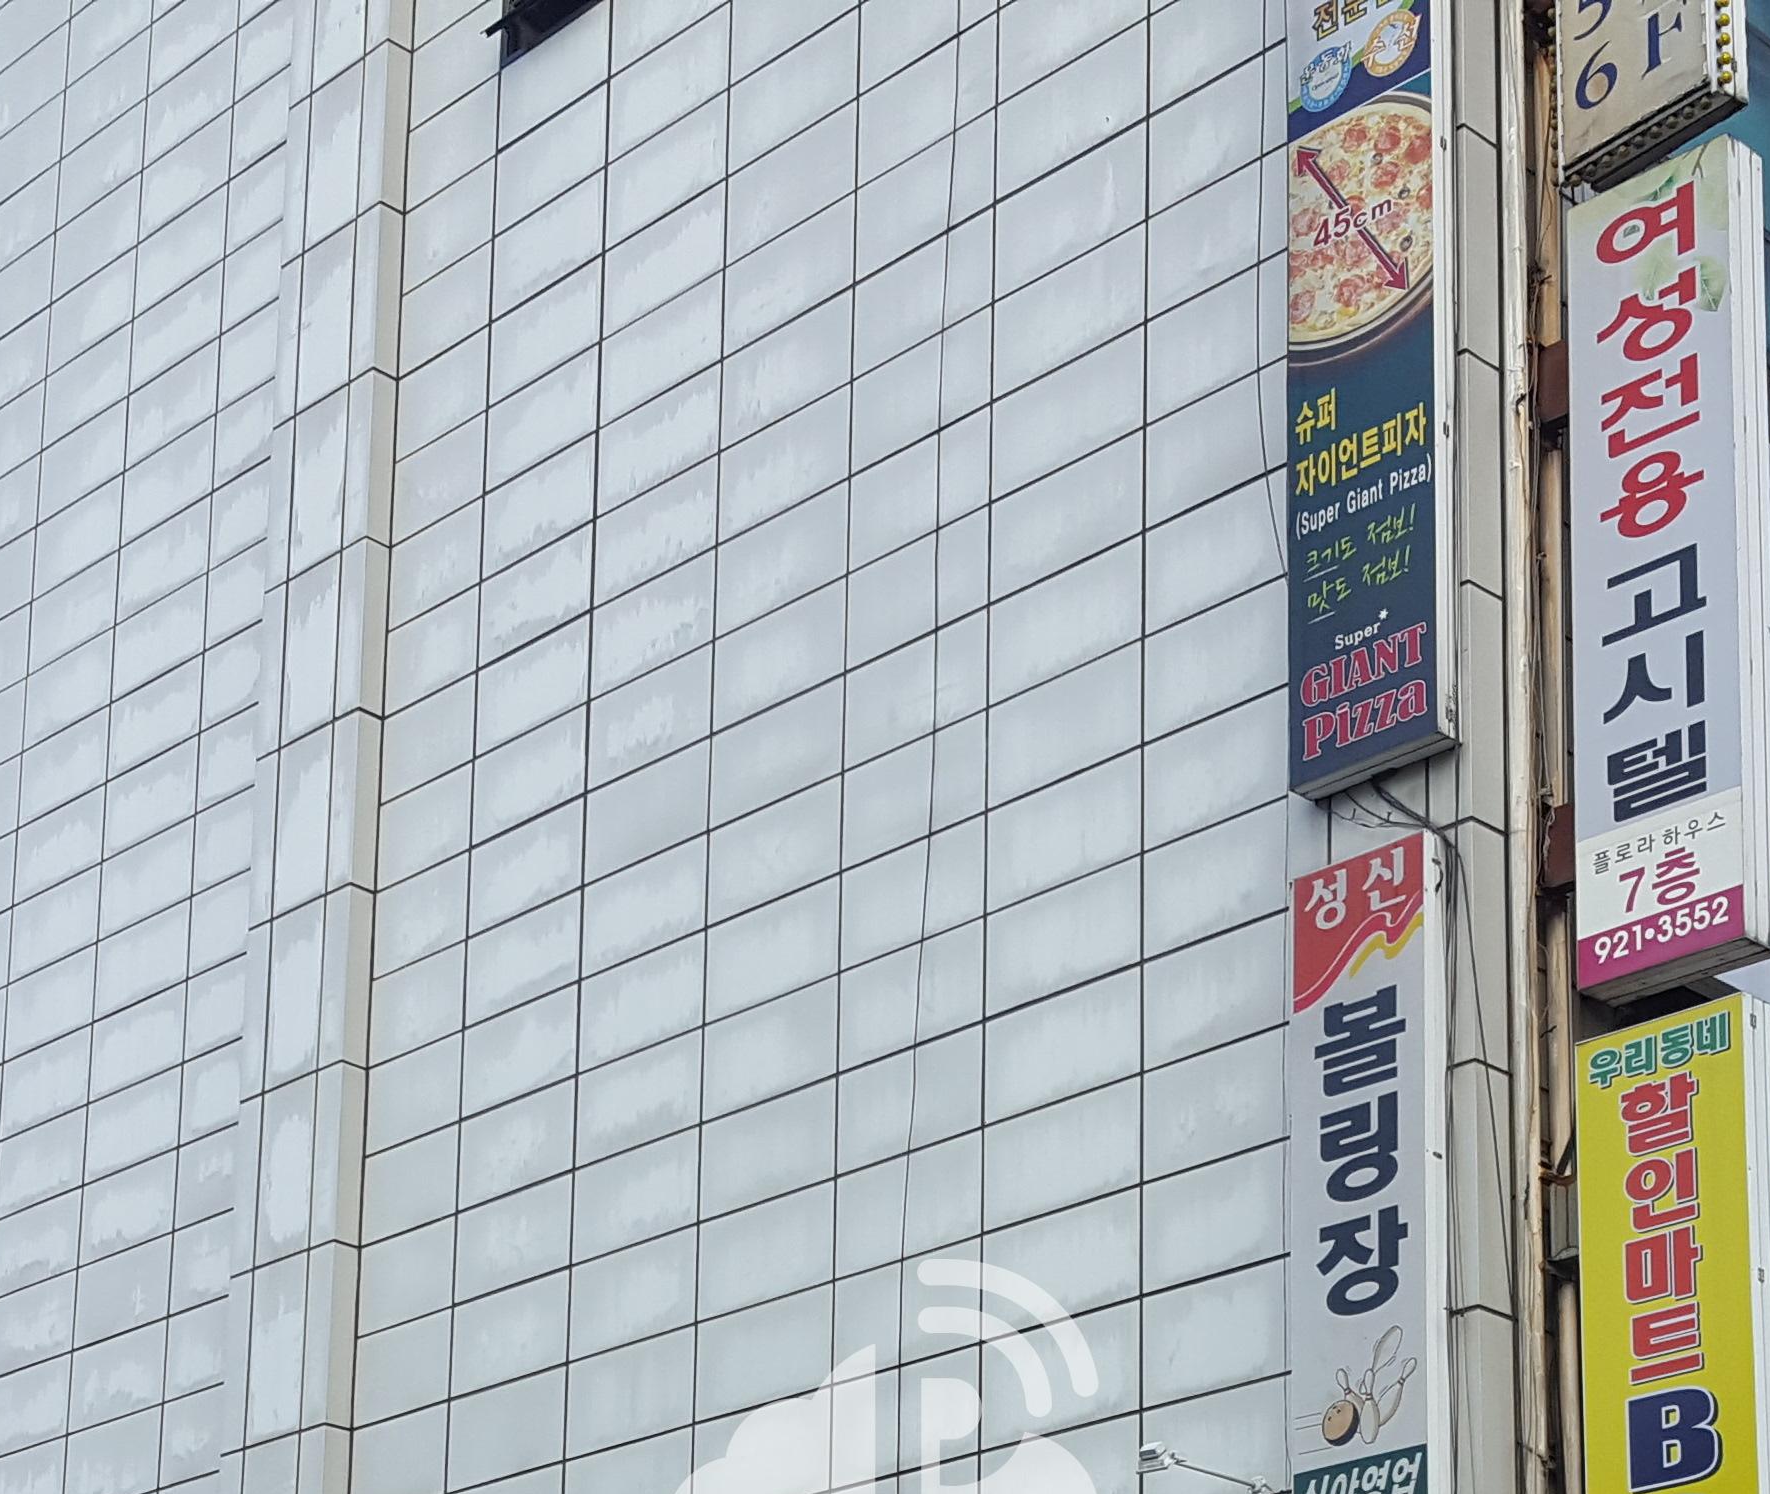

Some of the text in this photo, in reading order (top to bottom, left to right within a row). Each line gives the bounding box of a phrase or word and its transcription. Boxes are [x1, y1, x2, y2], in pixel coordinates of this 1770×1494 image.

[1313, 199, 1396, 249] 45cm
[1295, 388, 1337, 445] 슈퍼
[1295, 402, 1427, 496] 자이언트피자
[1295, 453, 1432, 540] (Super Giant Pizza)
[1300, 622, 1427, 708] GIANT
[1334, 622, 1381, 650] Super
[1302, 678, 1428, 761] Pizza
[1303, 845, 1406, 932] 성신
[1618, 846, 1702, 915] 7층
[1589, 1010, 1730, 1088] 우리동네
[1314, 984, 1409, 1318] 볼링장
